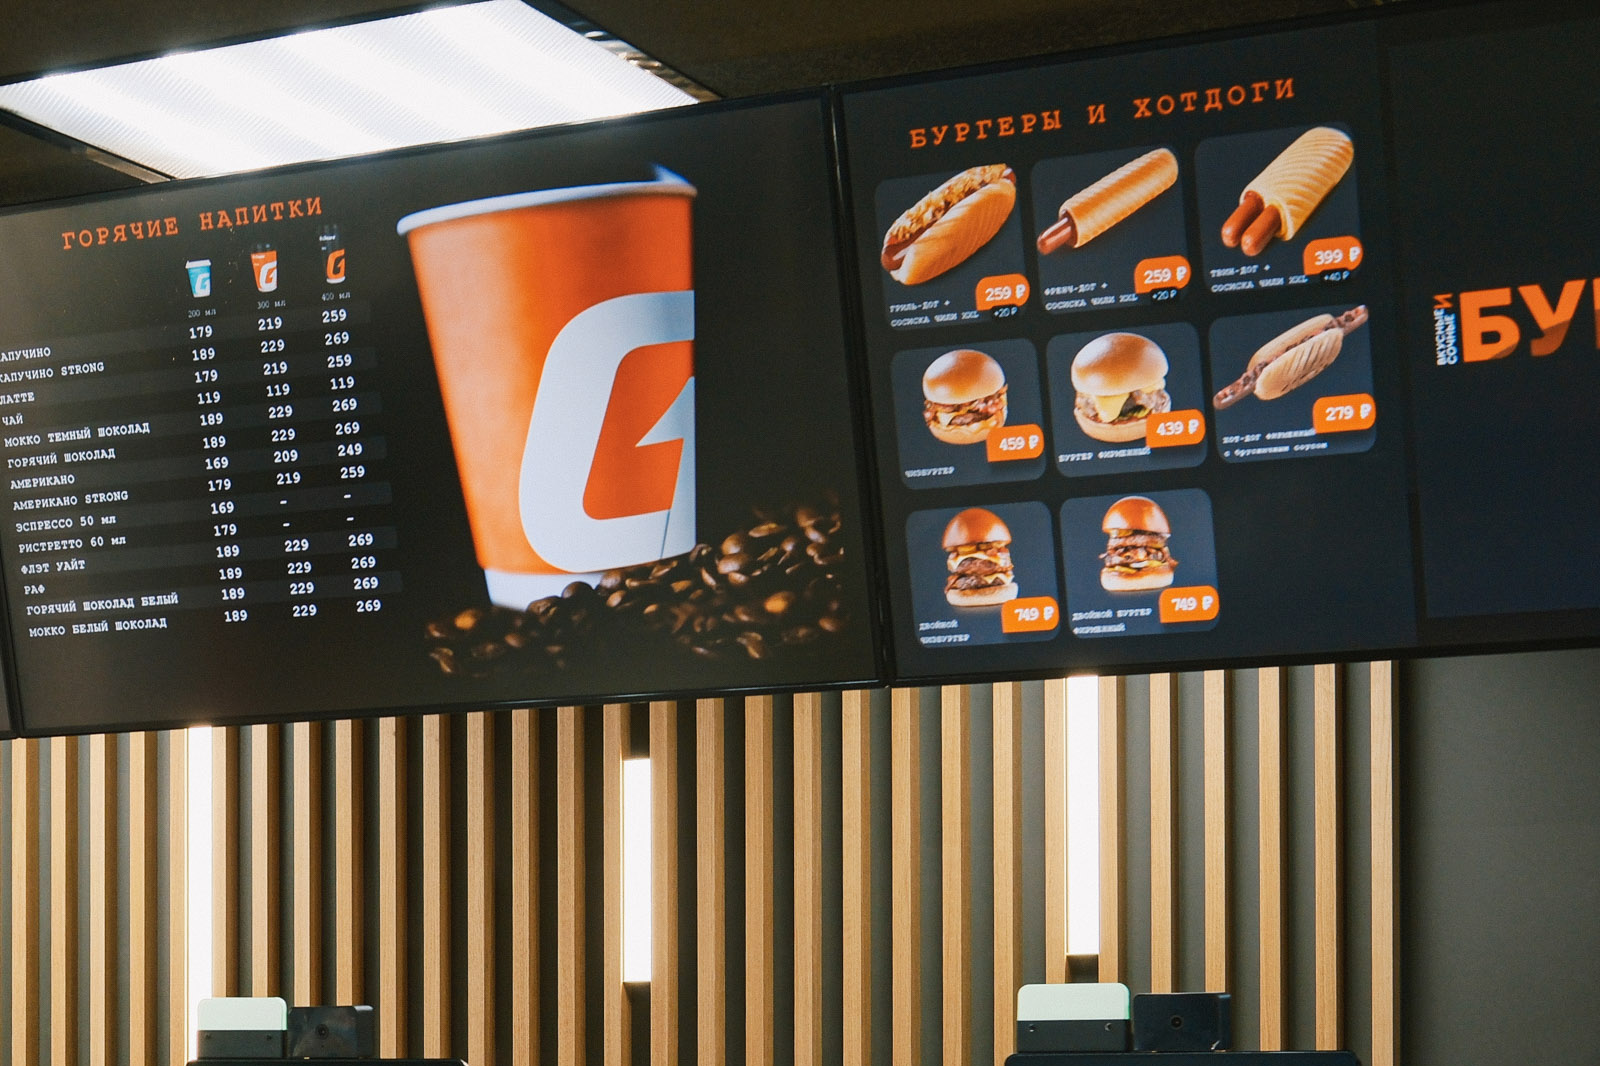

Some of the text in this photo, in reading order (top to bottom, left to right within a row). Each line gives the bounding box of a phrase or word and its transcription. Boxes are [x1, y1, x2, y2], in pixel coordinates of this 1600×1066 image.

[910, 78, 1295, 148] БУРГЕРЫ И ХОТДОГИ
[62, 197, 323, 249] ГОРЯЧИЕ НАПИТКИ
[1314, 249, 1343, 265] 399
[1144, 268, 1172, 283] 259
[985, 286, 1013, 301] 259
[190, 326, 213, 338] 179
[258, 318, 282, 331] 219
[323, 310, 347, 323] 259
[61, 362, 104, 376] STRONG
[0, 392, 35, 404] ЛАТТЕ
[2, 414, 23, 425] ЧАЙ
[1325, 405, 1354, 421] 279
[5, 423, 151, 447] МОККО ТЕМНЫЙ ШОКОЛАД
[1156, 421, 1184, 436] 439
[999, 436, 1026, 451] 459
[8, 448, 116, 468] ГОРЯЧИЙ ШОКОЛАД
[10, 474, 75, 489] АМЕРИКАНО
[13, 490, 129, 511] АМЕРИКАНО STRONG
[16, 515, 116, 532] ЭСПРЕССО 50 мл
[19, 535, 126, 553] РИСТРЕТТО 60 мл
[21, 558, 86, 574] ФЛЭТ УАЙТ
[24, 584, 45, 595] РАФ
[27, 593, 178, 616] ГОРЯЧИЙ ШОКОЛАД БЕЛЫЙ
[1171, 597, 1199, 612] 749
[30, 617, 167, 637] МОККО БЕЛЫЙ ШОКОЛАД
